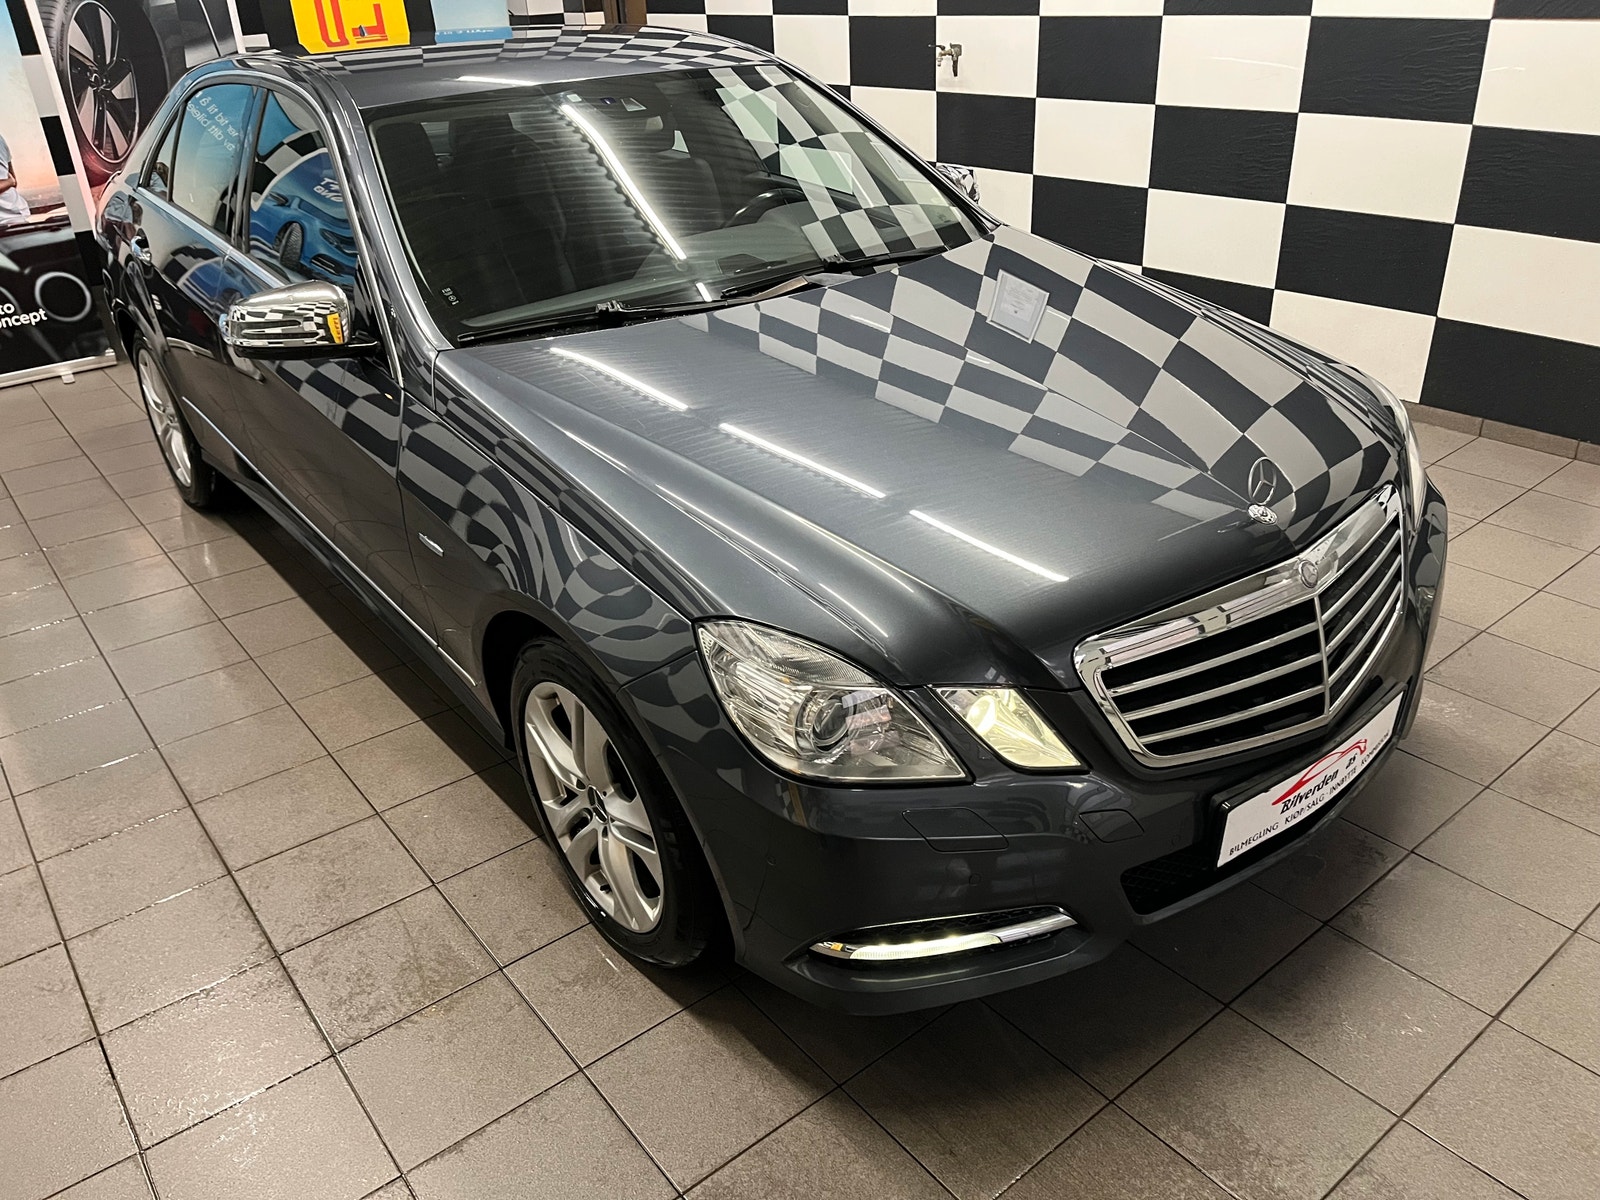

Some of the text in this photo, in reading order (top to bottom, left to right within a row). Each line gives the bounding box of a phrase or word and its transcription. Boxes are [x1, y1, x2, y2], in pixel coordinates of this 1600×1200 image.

[0, 308, 48, 328] ncept
[1280, 769, 1339, 815] Bilverden
[1229, 821, 1279, 856] BILMEGLING
